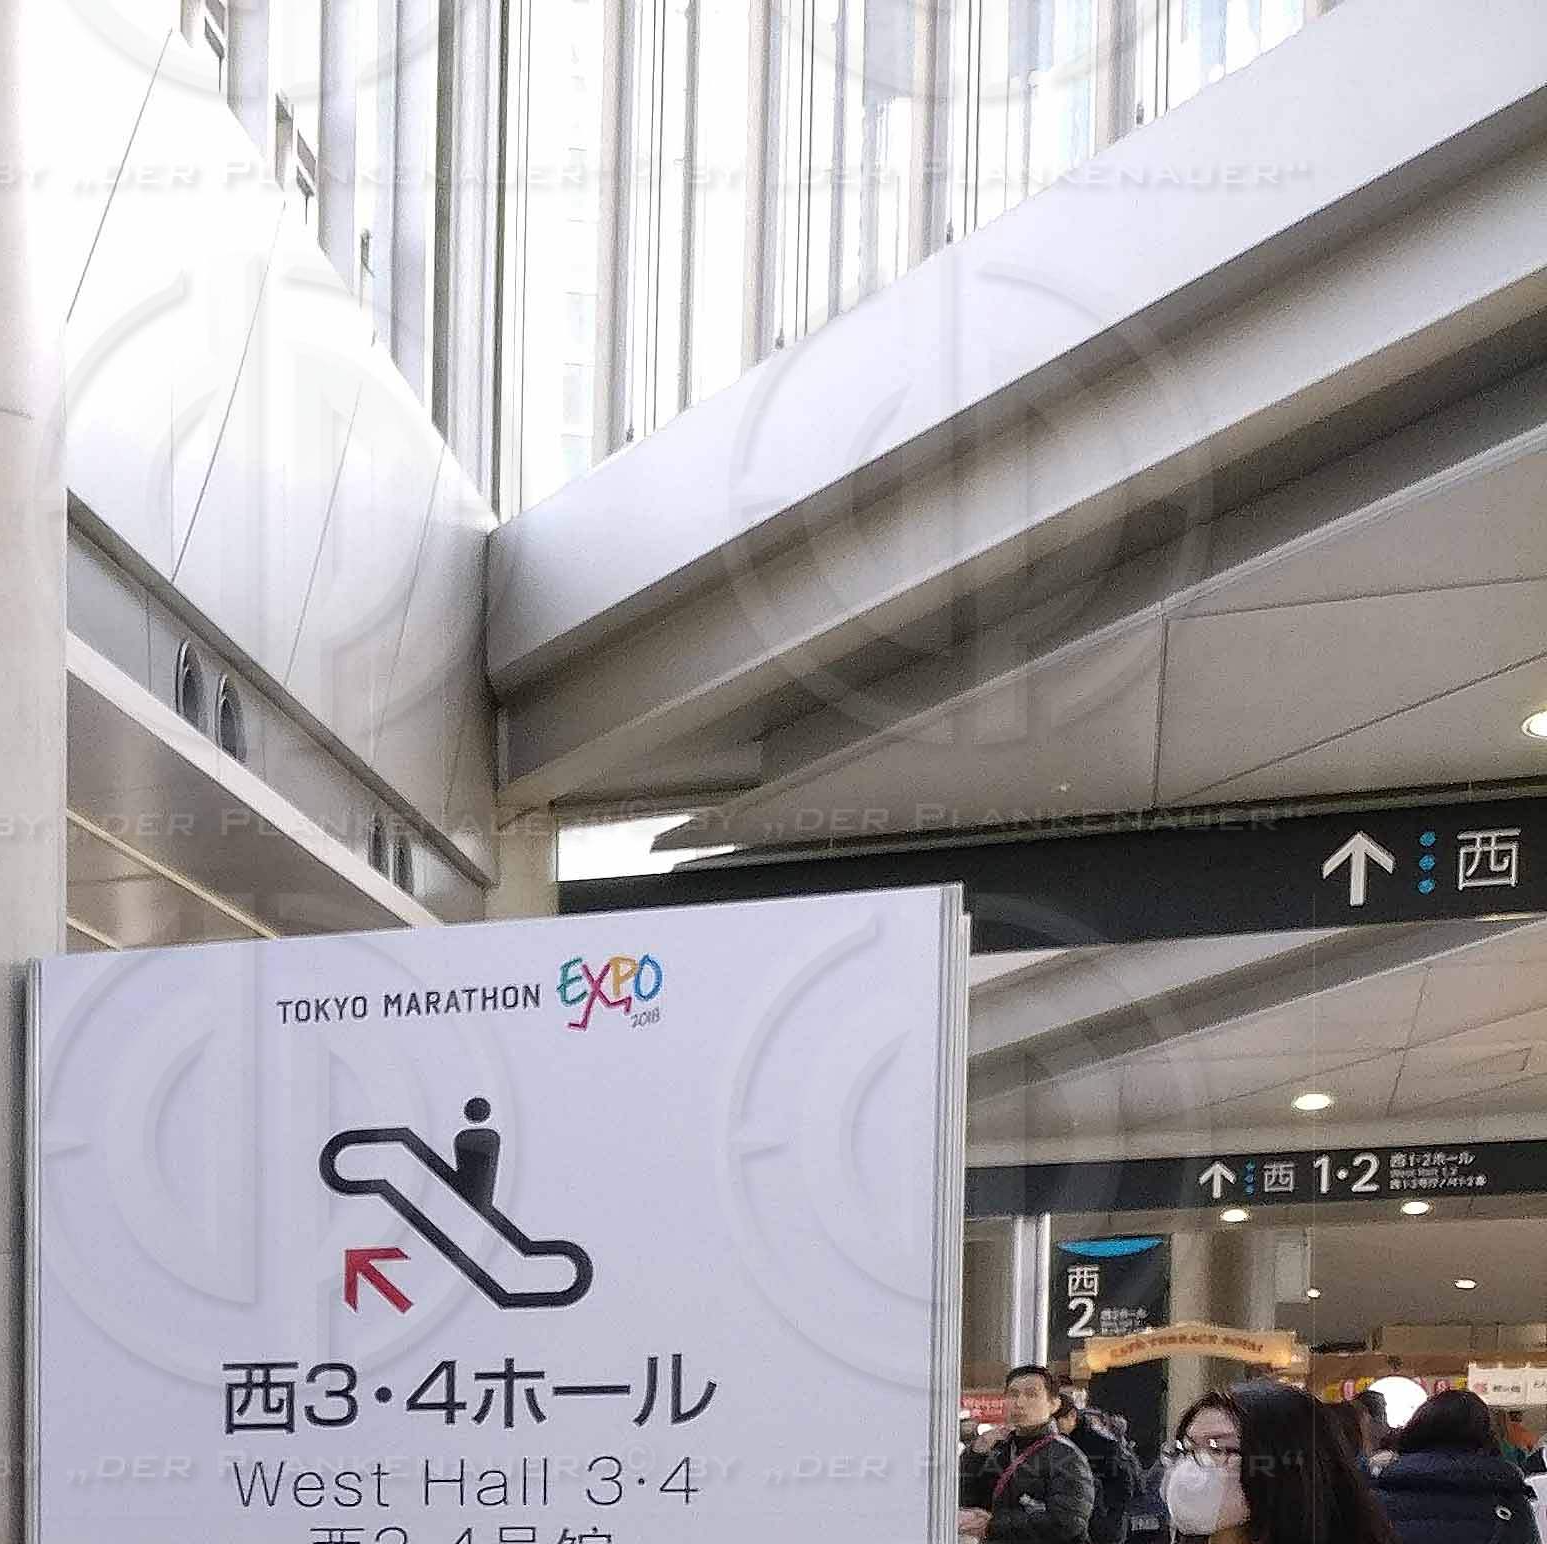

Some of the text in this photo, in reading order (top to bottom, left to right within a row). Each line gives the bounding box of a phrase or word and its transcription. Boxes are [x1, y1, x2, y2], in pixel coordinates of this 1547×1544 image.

[1457, 828, 1522, 891] 西
[277, 954, 664, 1030] TOKYO MARATHON EXPO
[1263, 1161, 1295, 1193] 西
[1067, 1264, 1100, 1297] 西
[1067, 1298, 1095, 1338] 2
[233, 1459, 390, 1508] West
[424, 1458, 548, 1506] Hall
